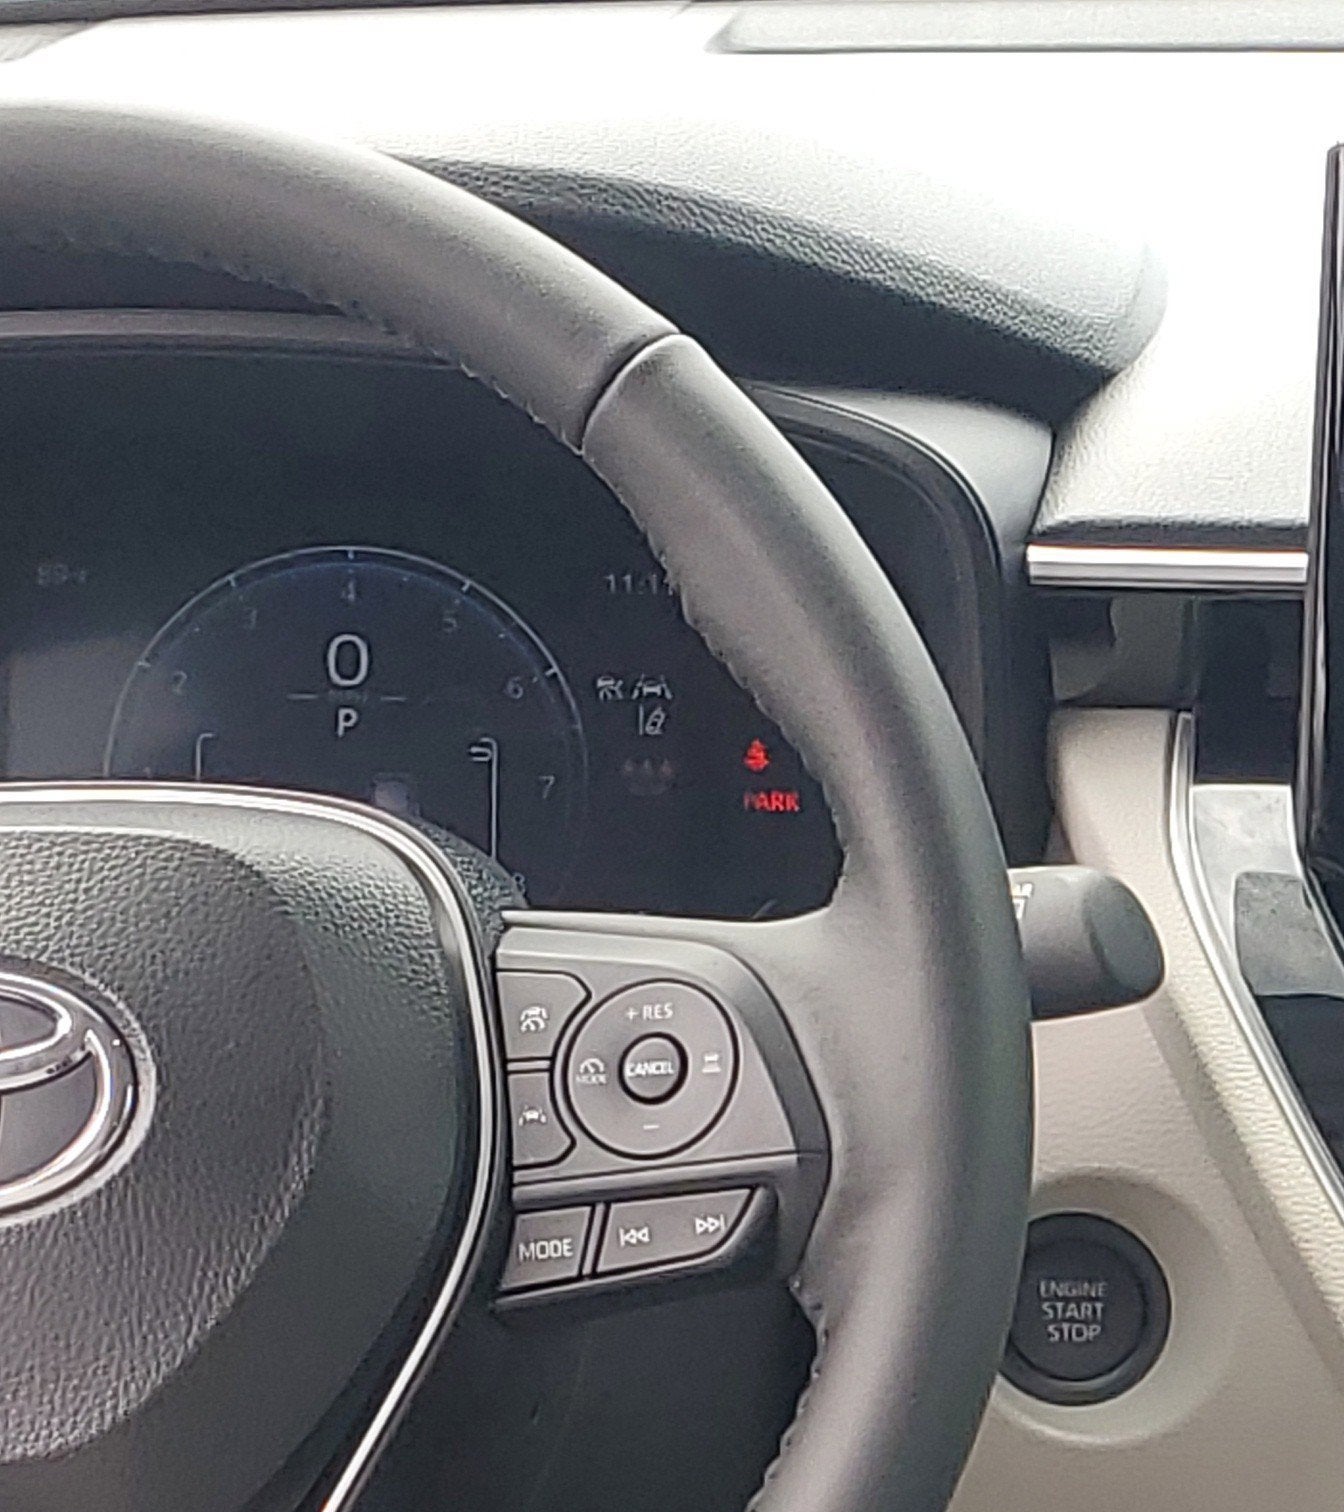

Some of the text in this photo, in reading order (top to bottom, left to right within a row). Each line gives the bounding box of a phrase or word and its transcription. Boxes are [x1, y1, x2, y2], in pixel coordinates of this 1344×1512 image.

[336, 707, 359, 737] P
[643, 1003, 673, 1020] RES
[625, 1060, 675, 1078] CANCEL
[518, 1237, 574, 1260] MODE
[1039, 1280, 1108, 1299] ENGINE
[1041, 1301, 1104, 1321] START
[1047, 1322, 1101, 1343] STOP
